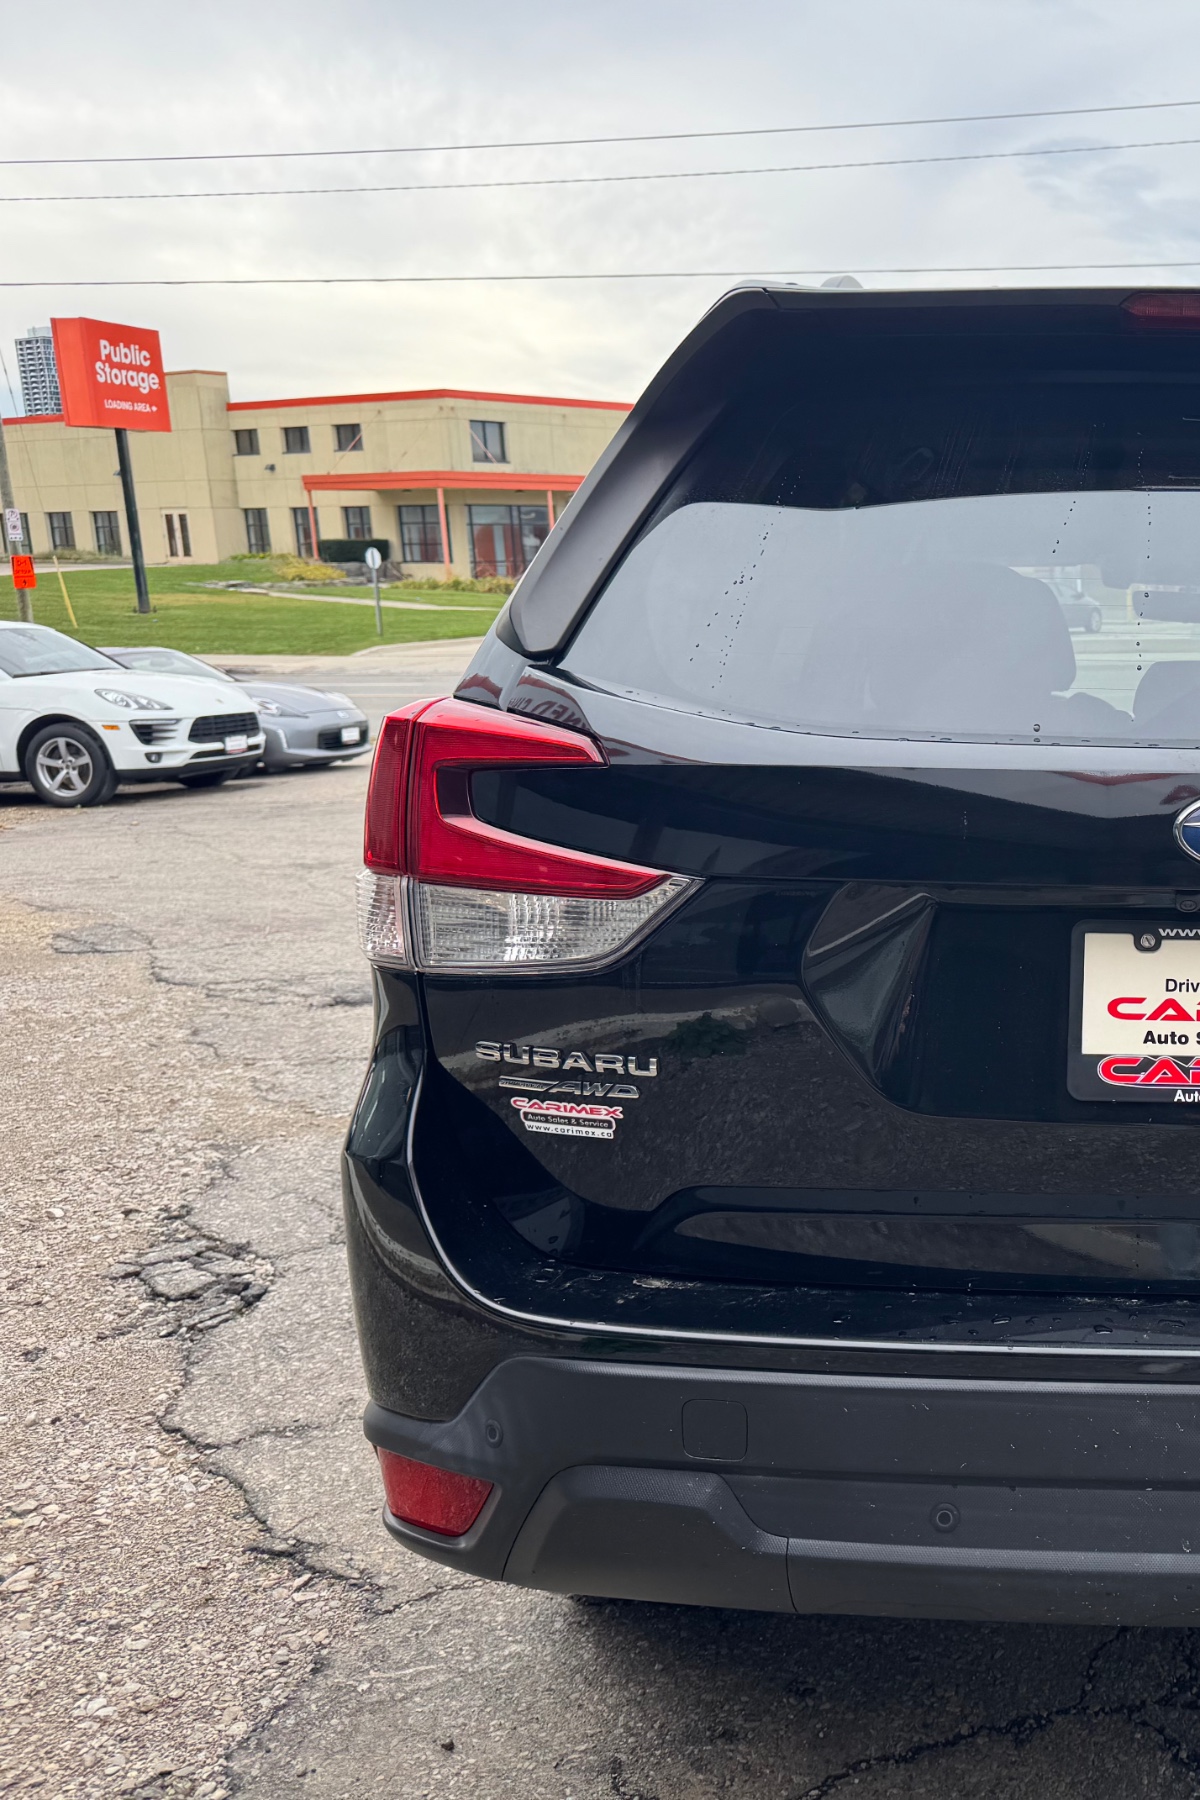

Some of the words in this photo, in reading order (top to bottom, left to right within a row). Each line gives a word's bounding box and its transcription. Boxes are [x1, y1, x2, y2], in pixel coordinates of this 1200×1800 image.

[99, 339, 151, 367] Public
[95, 361, 159, 394] Storage
[104, 399, 133, 411] LOADING
[134, 402, 151, 412] AREA
[1143, 1030, 1189, 1046] Auto
[475, 1040, 659, 1077] SUBARU
[549, 1081, 641, 1098] AWD
[511, 1098, 622, 1118] CARIMEX
[528, 1114, 545, 1122] Auto
[548, 1116, 569, 1124] Sales
[580, 1119, 609, 1128] Service
[526, 1123, 612, 1138] www.carimex.ca
